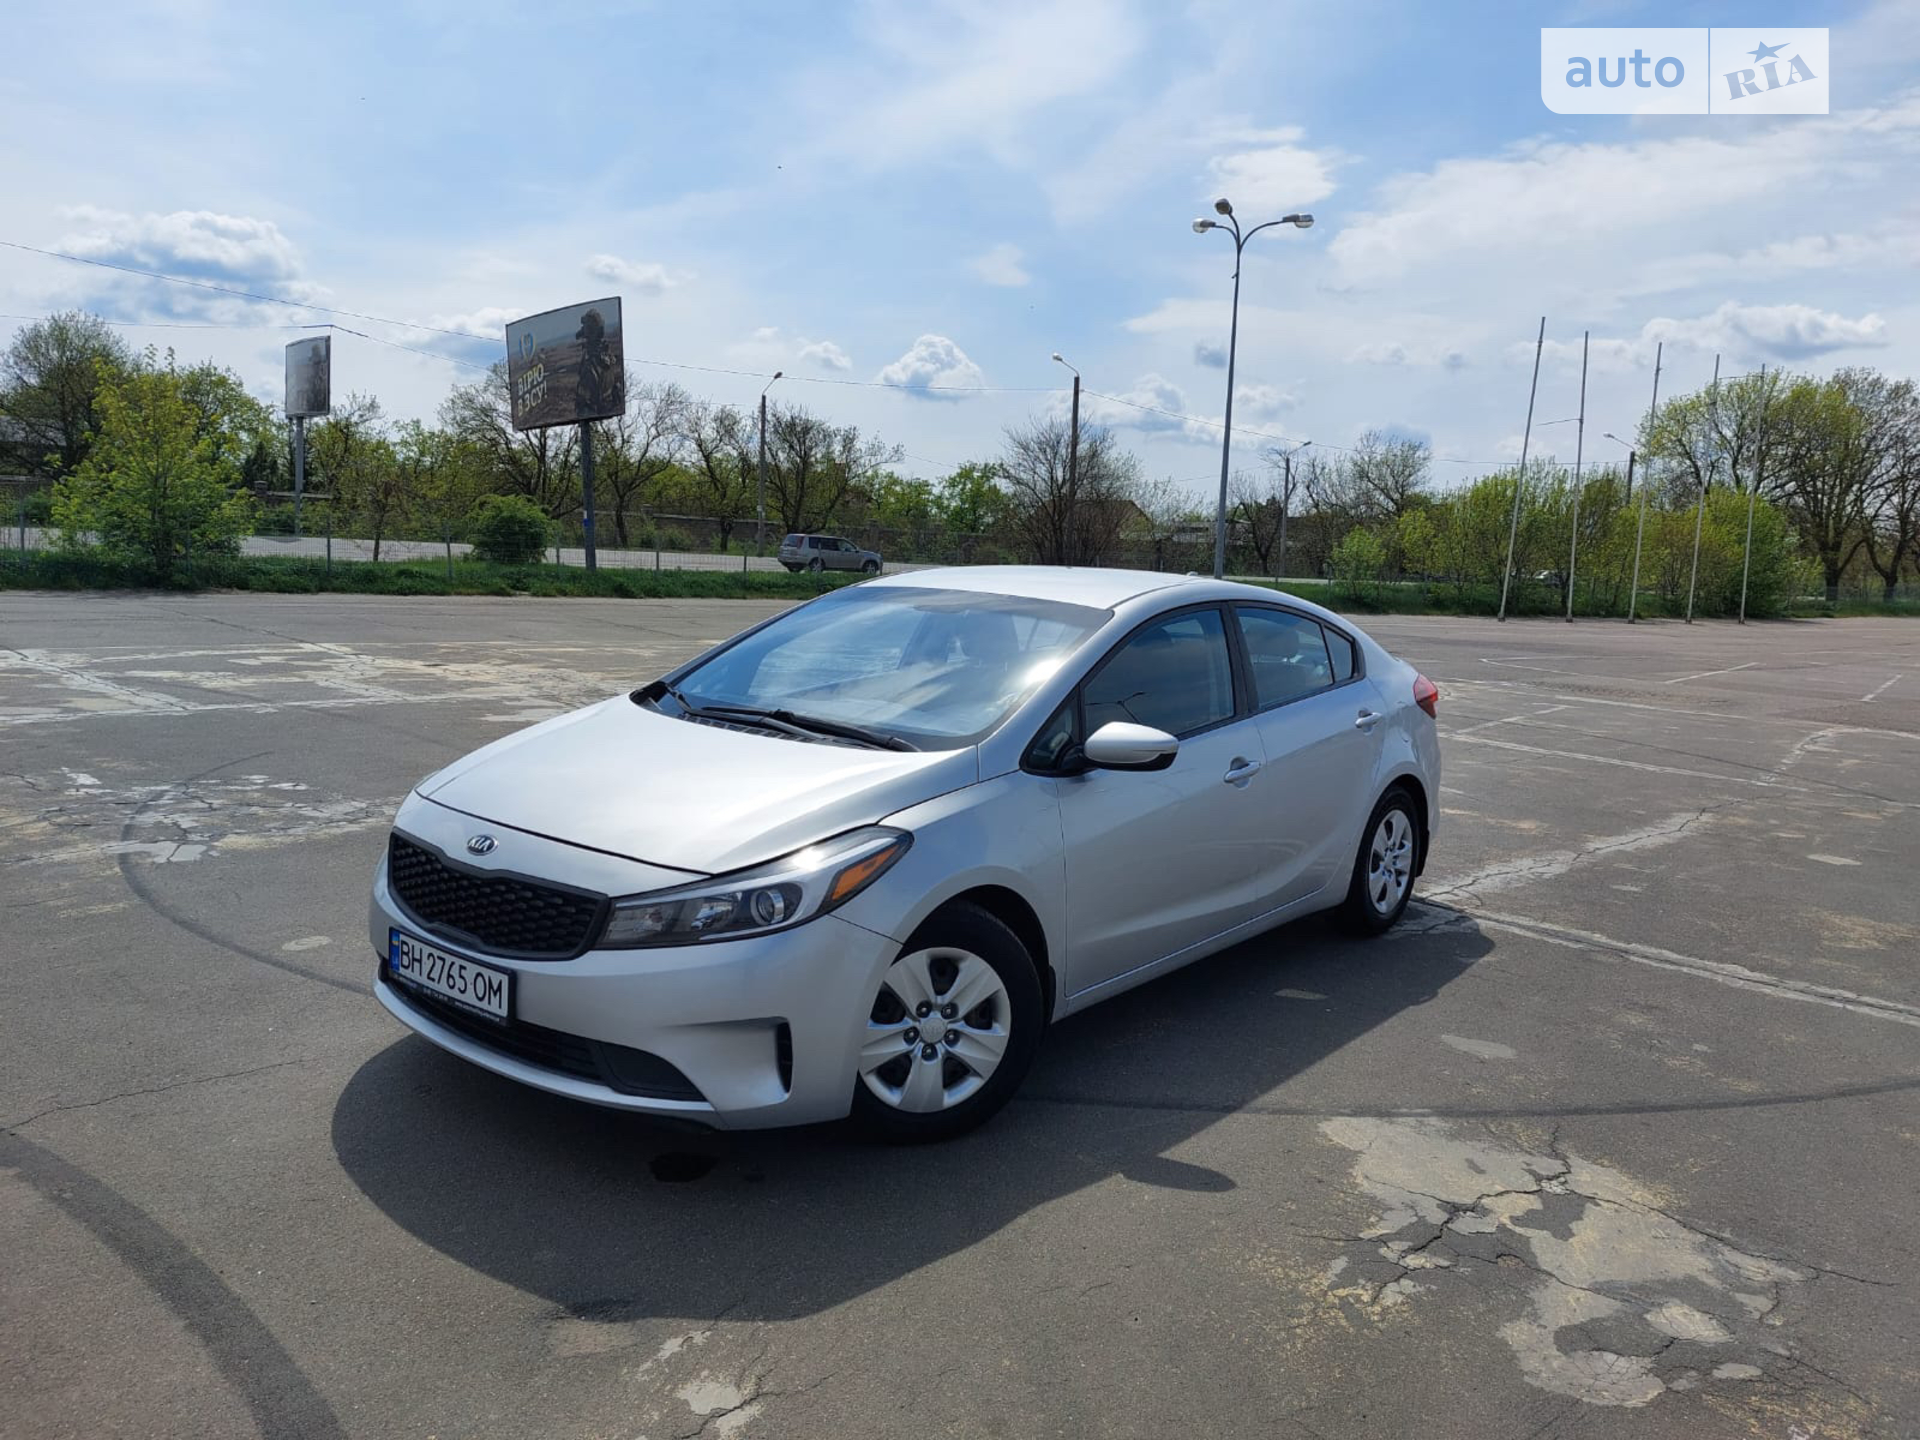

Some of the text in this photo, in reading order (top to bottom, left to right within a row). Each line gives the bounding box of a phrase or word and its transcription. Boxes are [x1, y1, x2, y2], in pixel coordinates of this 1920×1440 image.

[518, 363, 544, 395] ВІРЮ
[524, 380, 547, 411] ЗСУ!
[468, 837, 492, 852] KIA
[401, 940, 503, 1010] BH 2765 OM
